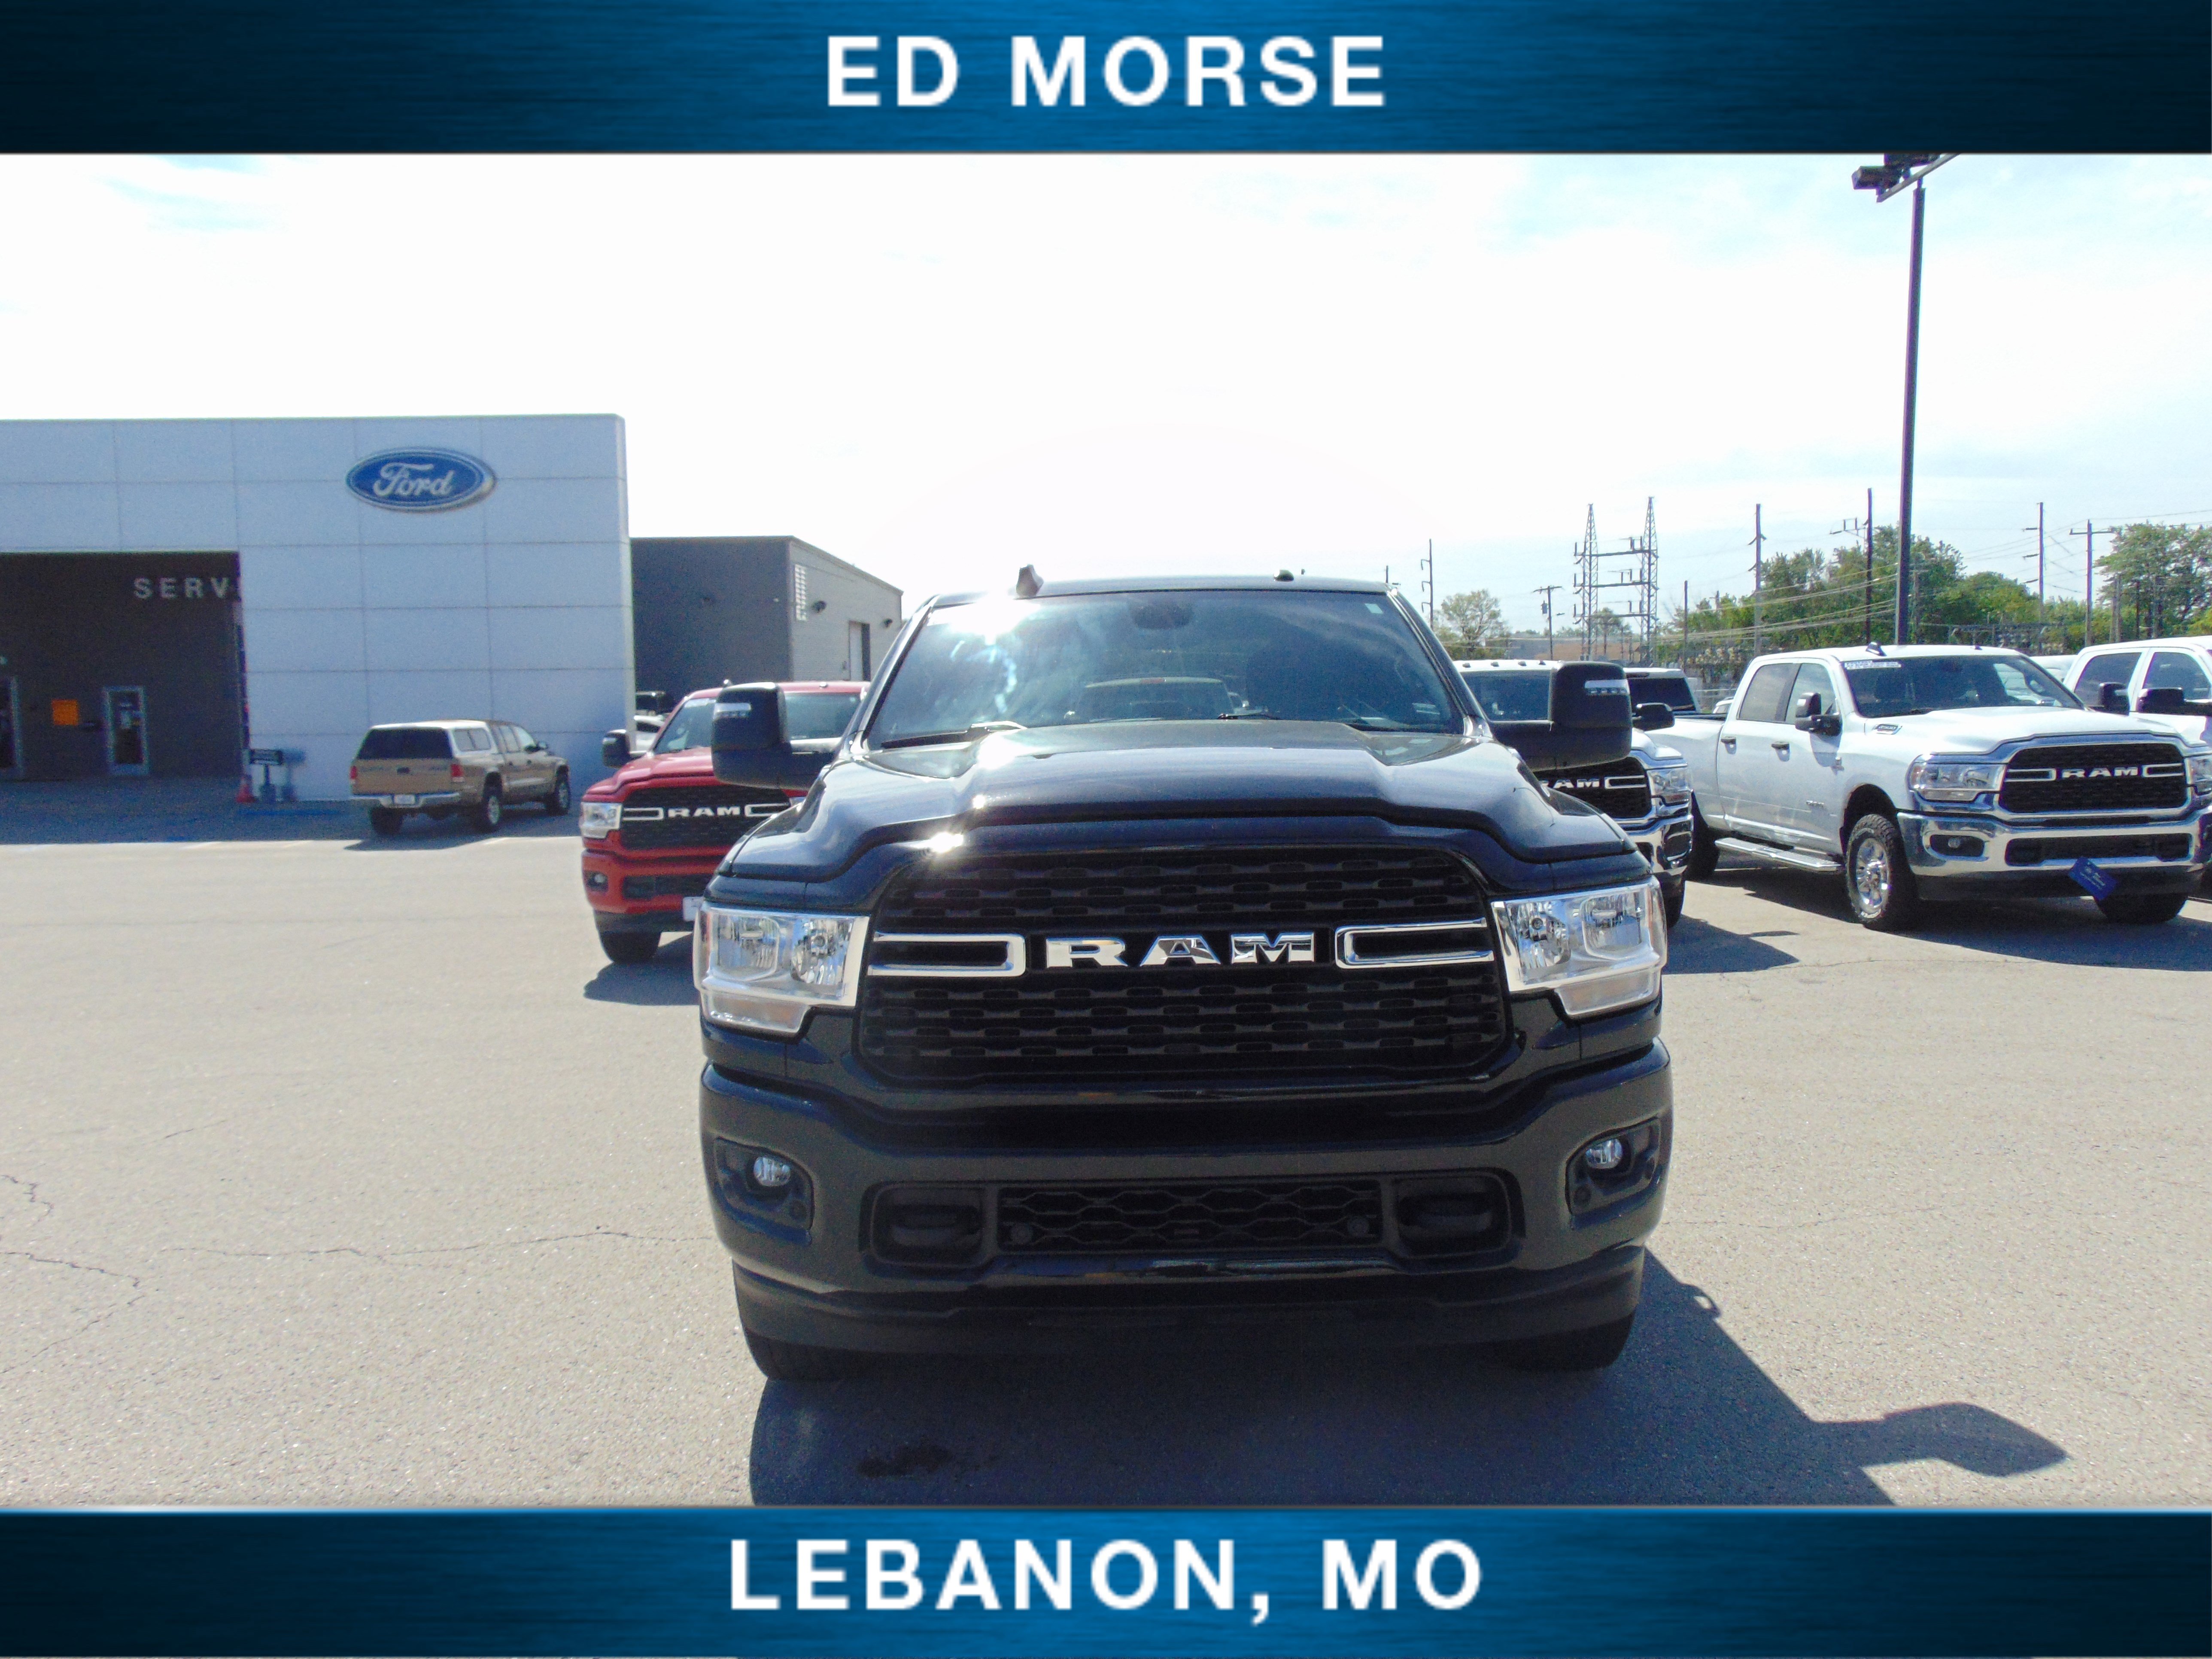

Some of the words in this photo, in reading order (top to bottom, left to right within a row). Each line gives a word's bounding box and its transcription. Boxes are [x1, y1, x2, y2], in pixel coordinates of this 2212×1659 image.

[372, 462, 454, 496] Ford
[134, 577, 231, 599] SERV
[2062, 767, 2139, 778] RAM
[668, 806, 740, 817] RAM
[1045, 932, 1315, 968] RAM
